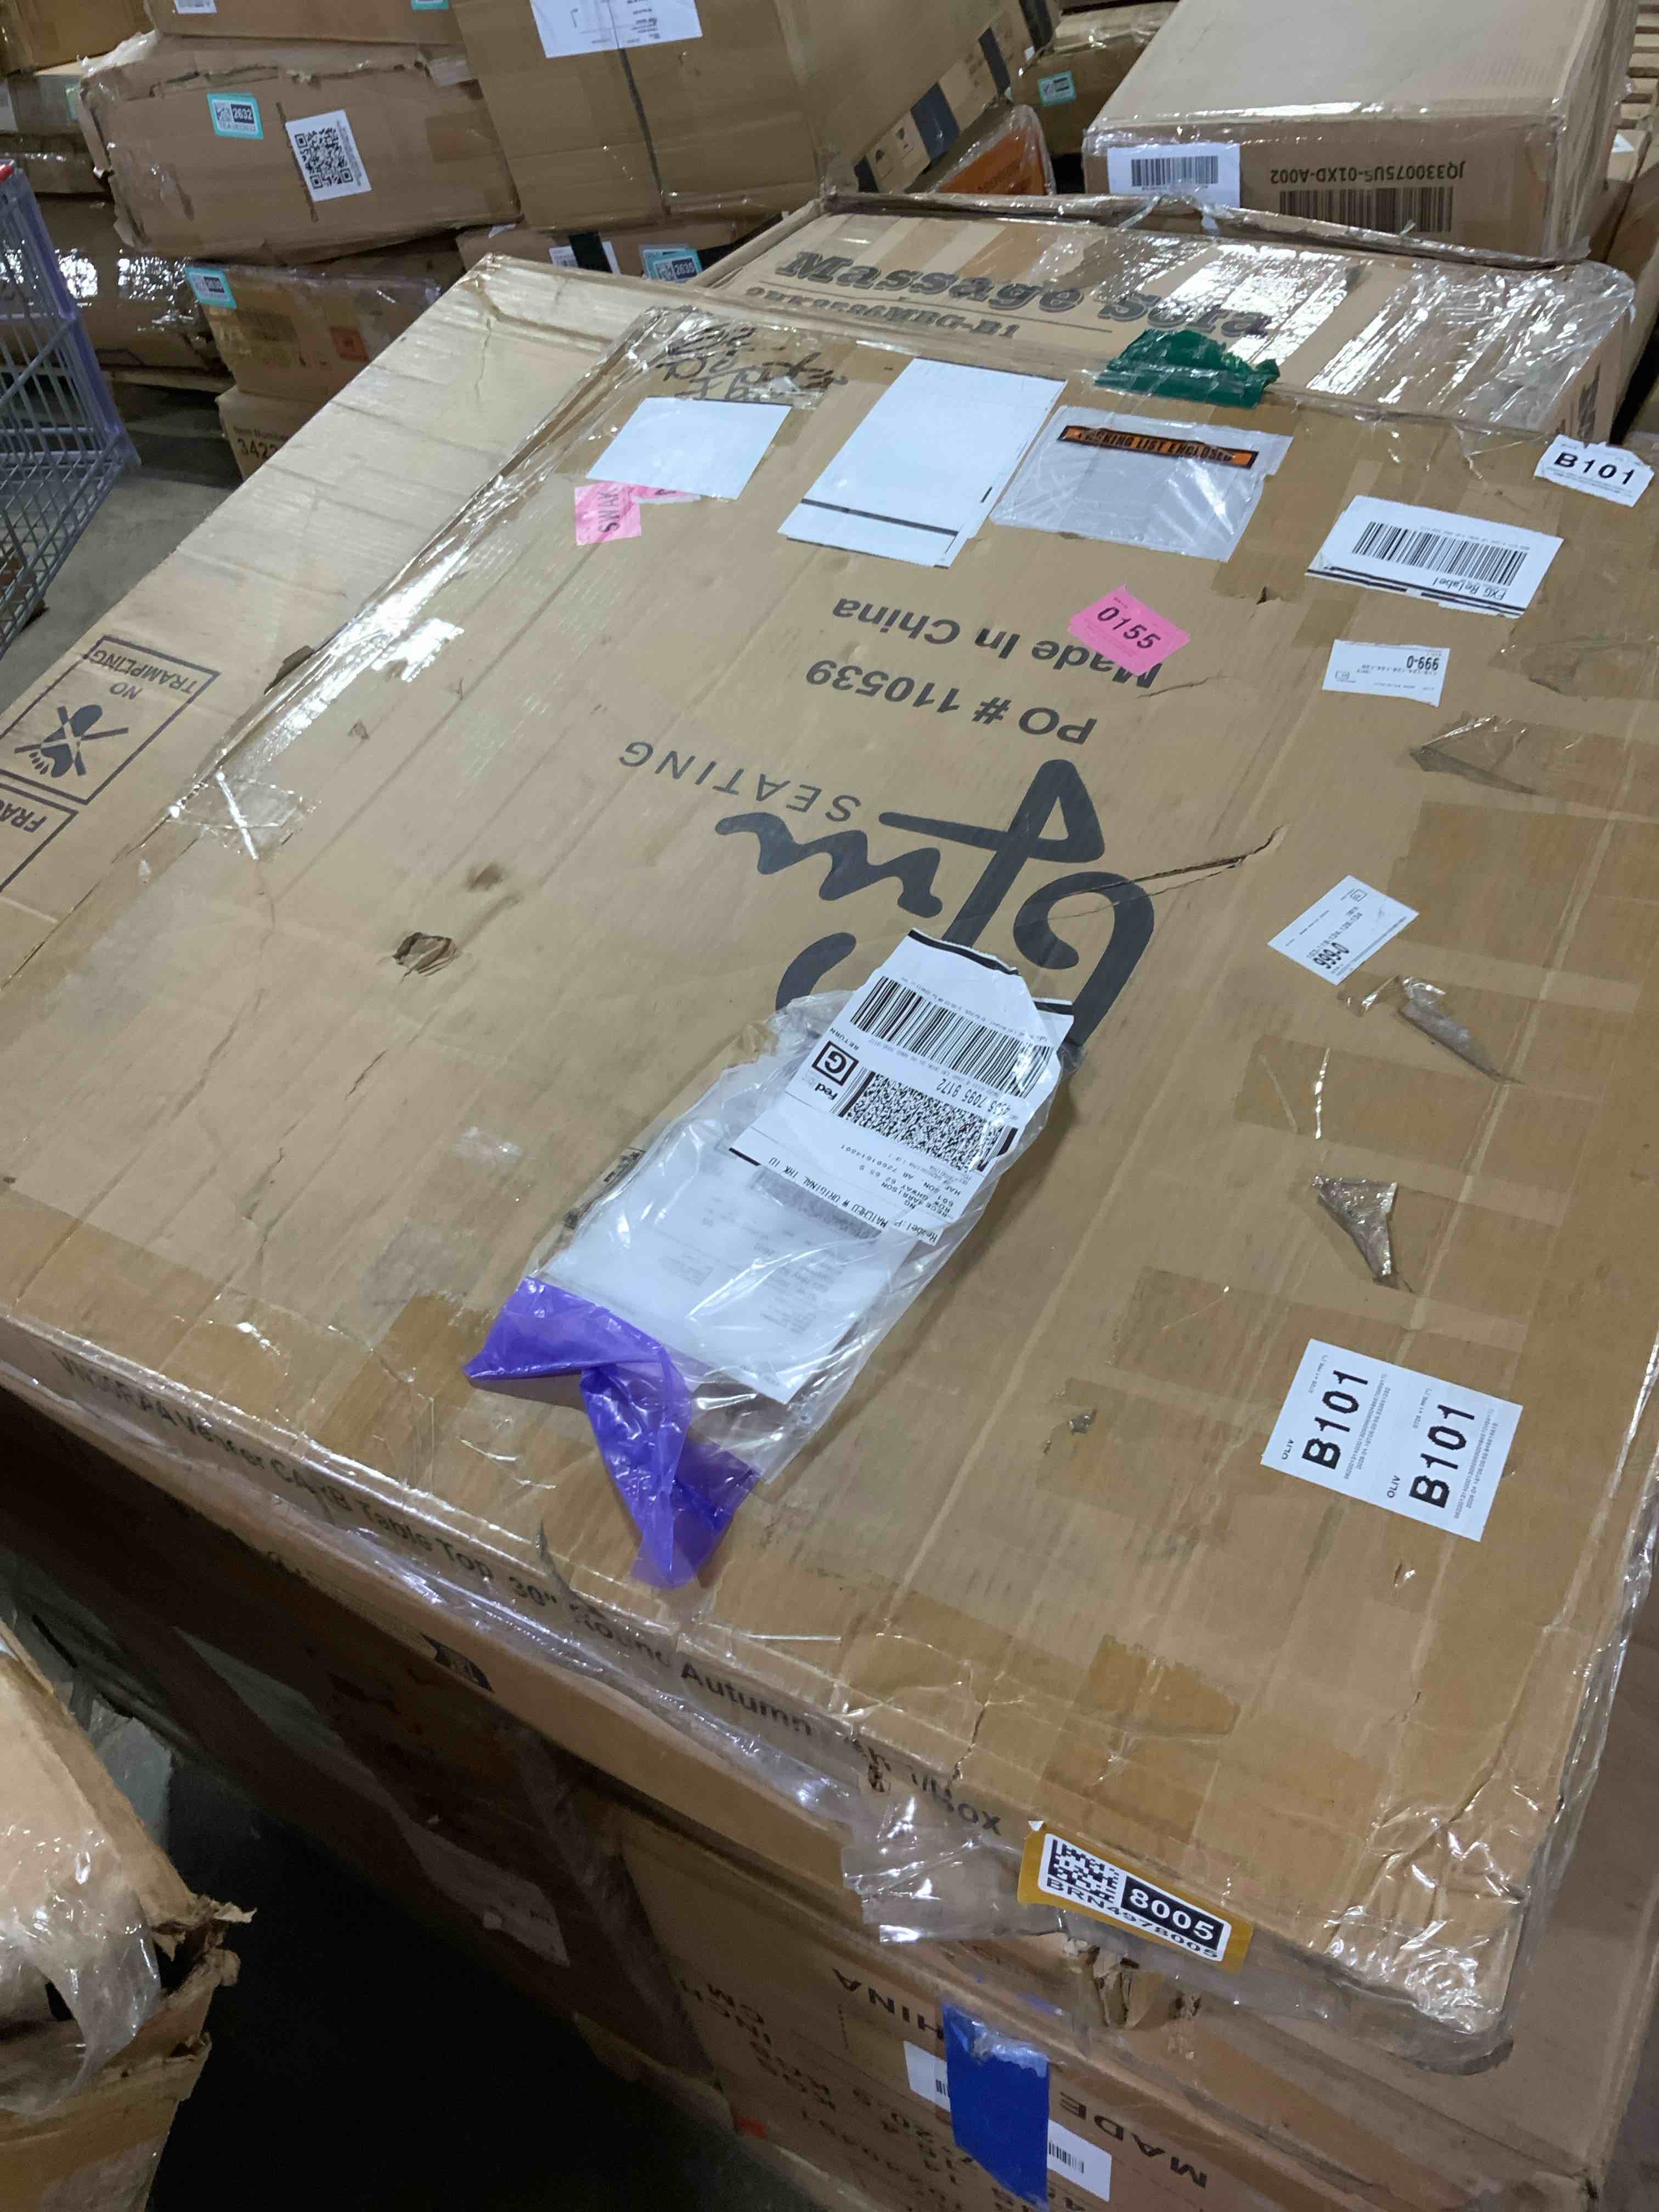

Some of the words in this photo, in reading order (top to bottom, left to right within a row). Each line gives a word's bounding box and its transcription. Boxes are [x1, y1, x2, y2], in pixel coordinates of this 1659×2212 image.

[1269, 159, 1466, 189] JQ330075US-01XD-A002
[774, 251, 1084, 313] Massage
[1554, 452, 1636, 486] B101
[832, 597, 961, 646] China
[1097, 606, 1162, 649] 0155
[974, 627, 1022, 660] In
[94, 649, 199, 695] TRAMPLING
[110, 682, 143, 701] NO
[805, 660, 961, 715] 110539
[971, 697, 1013, 725] #
[1018, 707, 1097, 746] PO
[618, 740, 863, 824] SEATING
[0, 800, 48, 833] FRA
[830, 1027, 860, 1051] RETURN
[824, 1050, 848, 1074] G
[936, 1078, 961, 1097] 9172
[962, 1090, 987, 1109] 7095
[1301, 1370, 1369, 1470] B101
[1408, 1404, 1475, 1509] B101
[1386, 1475, 1401, 1498] OLIV
[438, 1538, 494, 1579] Top
[681, 1662, 812, 1737] Autumn
[1046, 1877, 1218, 1959] BRN4978005
[1130, 1888, 1214, 1941] 8005
[831, 1966, 945, 2040] HINA
[1059, 2091, 1209, 2190] MADE
